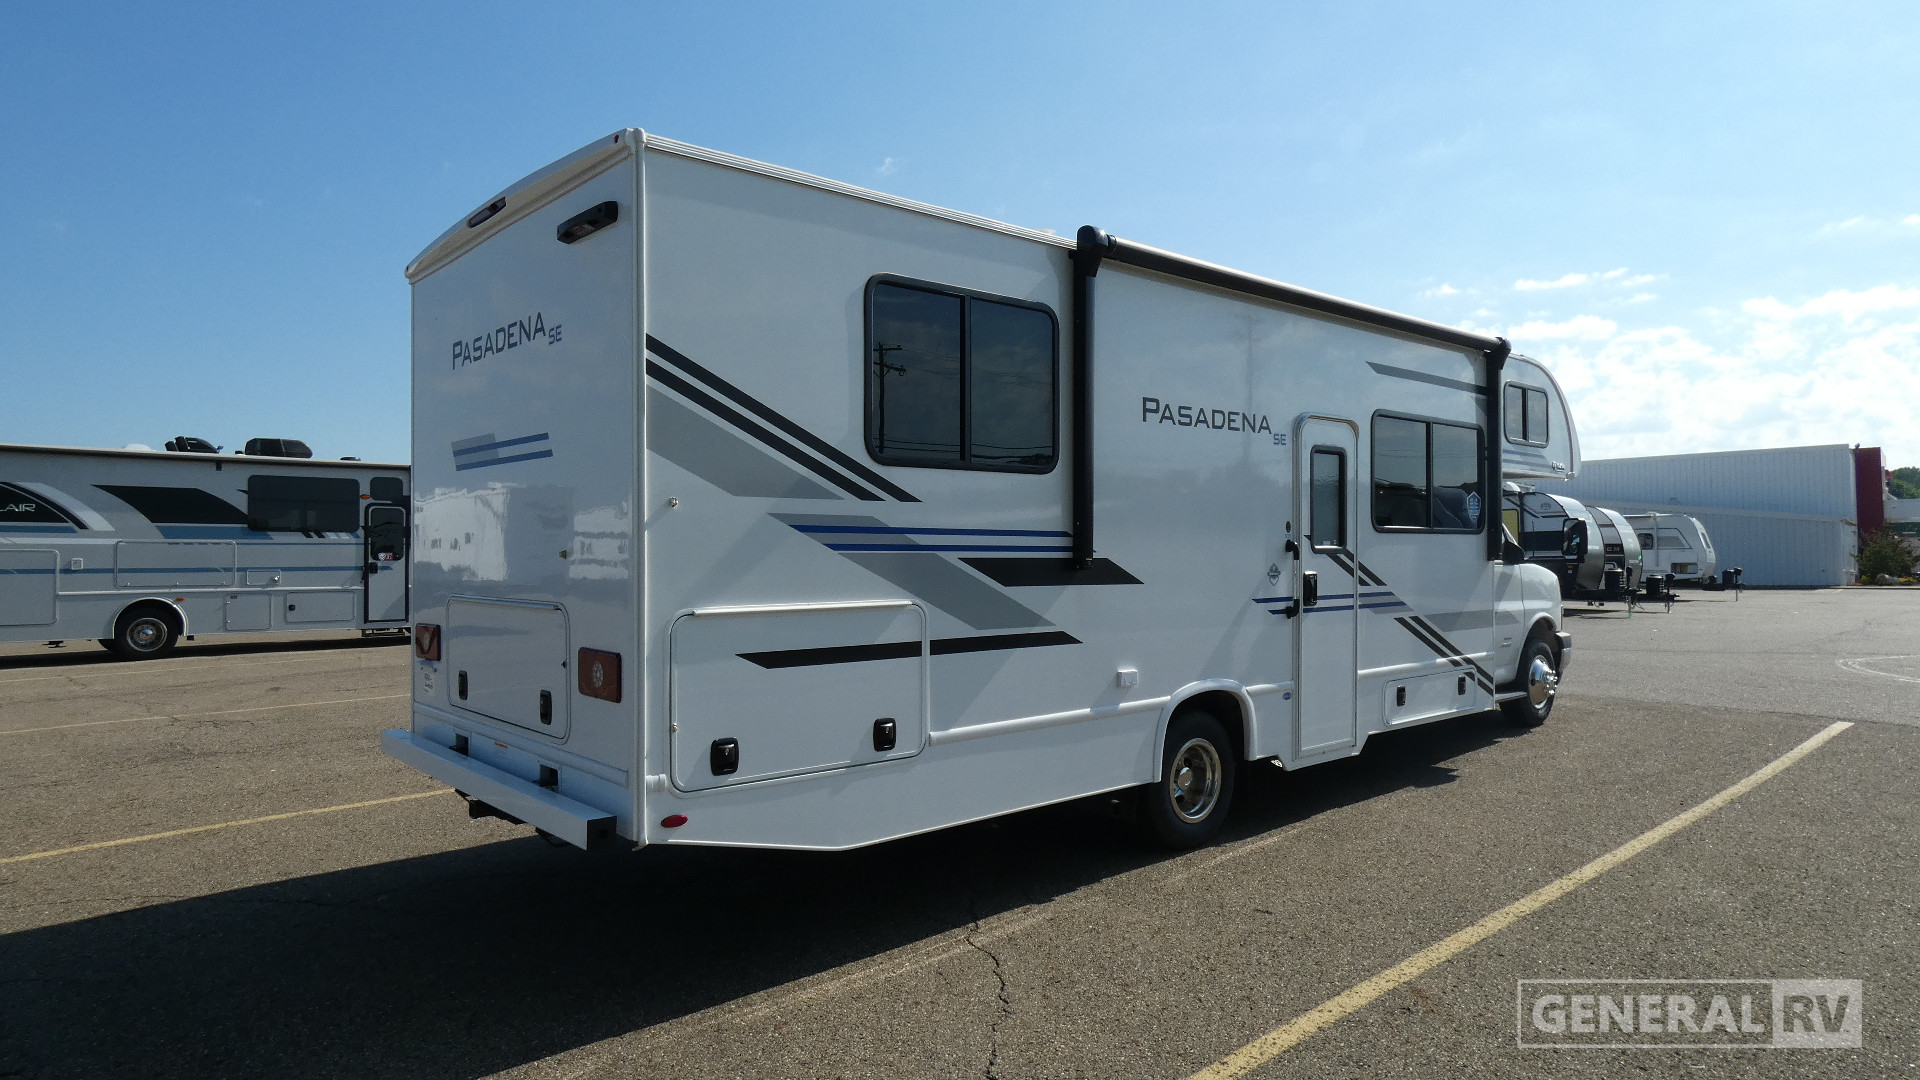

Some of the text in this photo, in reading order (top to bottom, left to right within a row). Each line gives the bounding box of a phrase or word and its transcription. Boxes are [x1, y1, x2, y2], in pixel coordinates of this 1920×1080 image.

[452, 311, 562, 370] PASADENA SE
[1142, 396, 1287, 446] PASADENA SE
